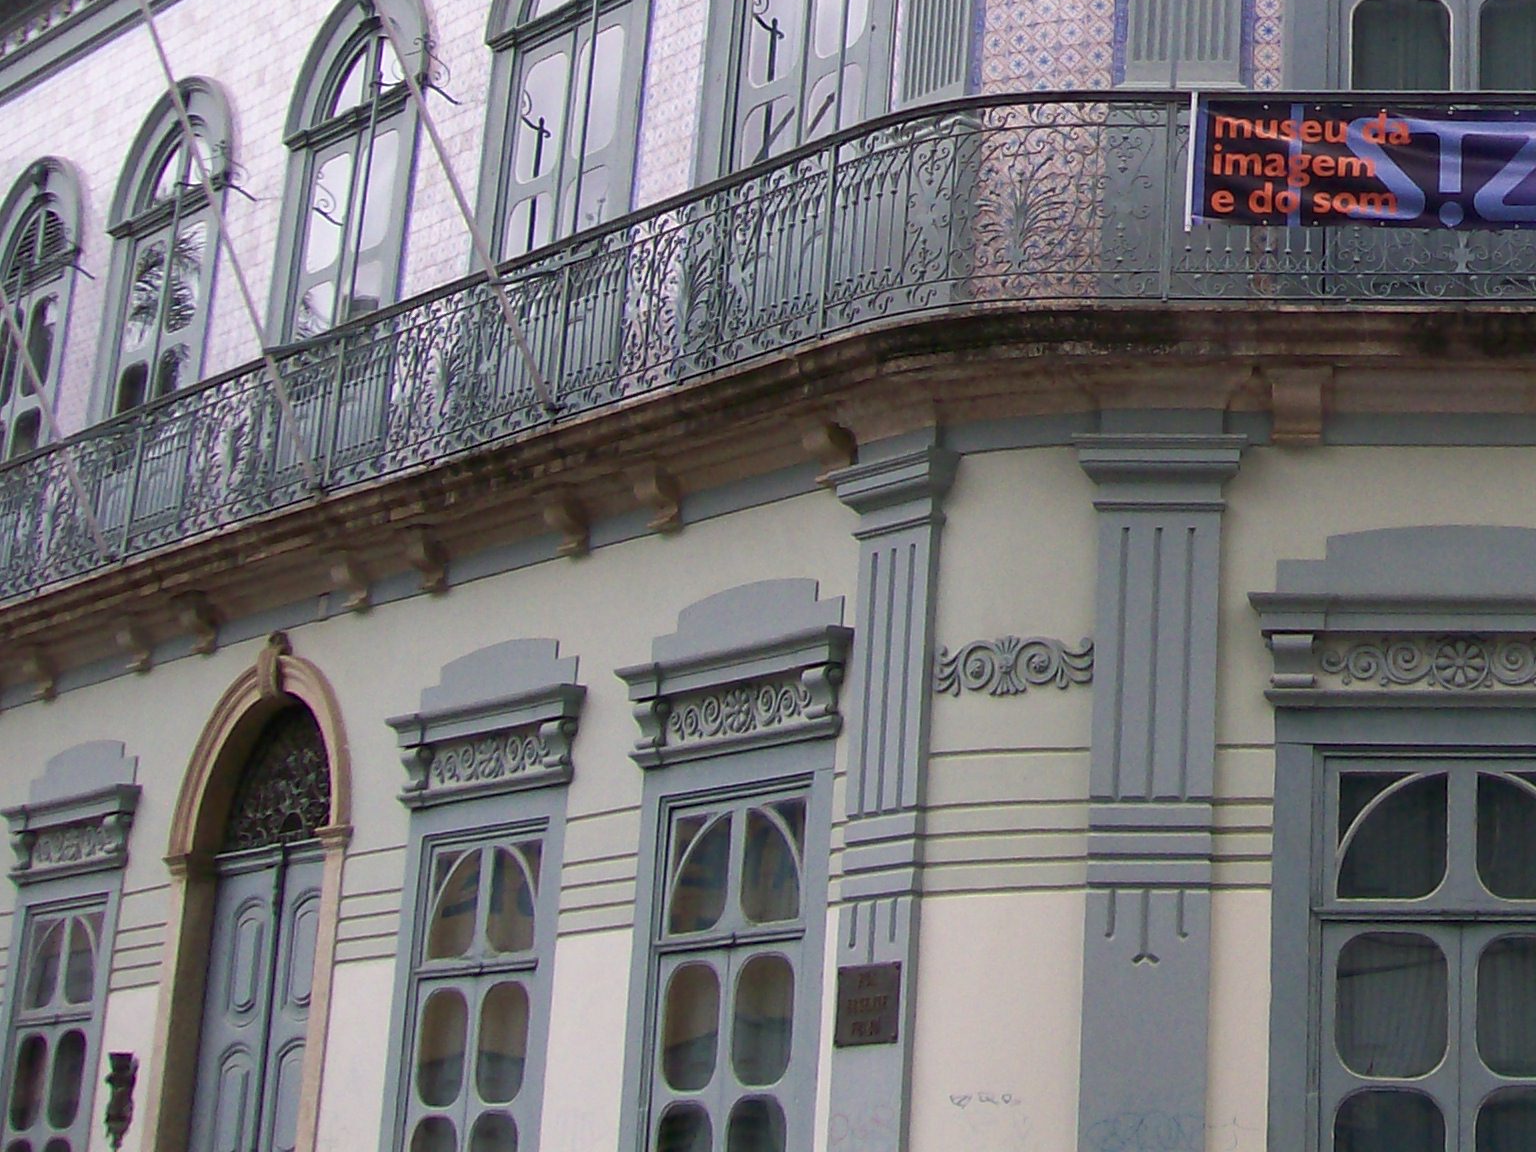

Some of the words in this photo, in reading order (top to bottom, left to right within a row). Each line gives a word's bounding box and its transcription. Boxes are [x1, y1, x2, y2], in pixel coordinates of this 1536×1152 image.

[1214, 115, 1348, 143] museu
[1361, 112, 1411, 145] da
[1211, 143, 1377, 187] imagem
[1210, 189, 1234, 213] e
[1248, 181, 1298, 214] do
[1312, 190, 1398, 215] som
